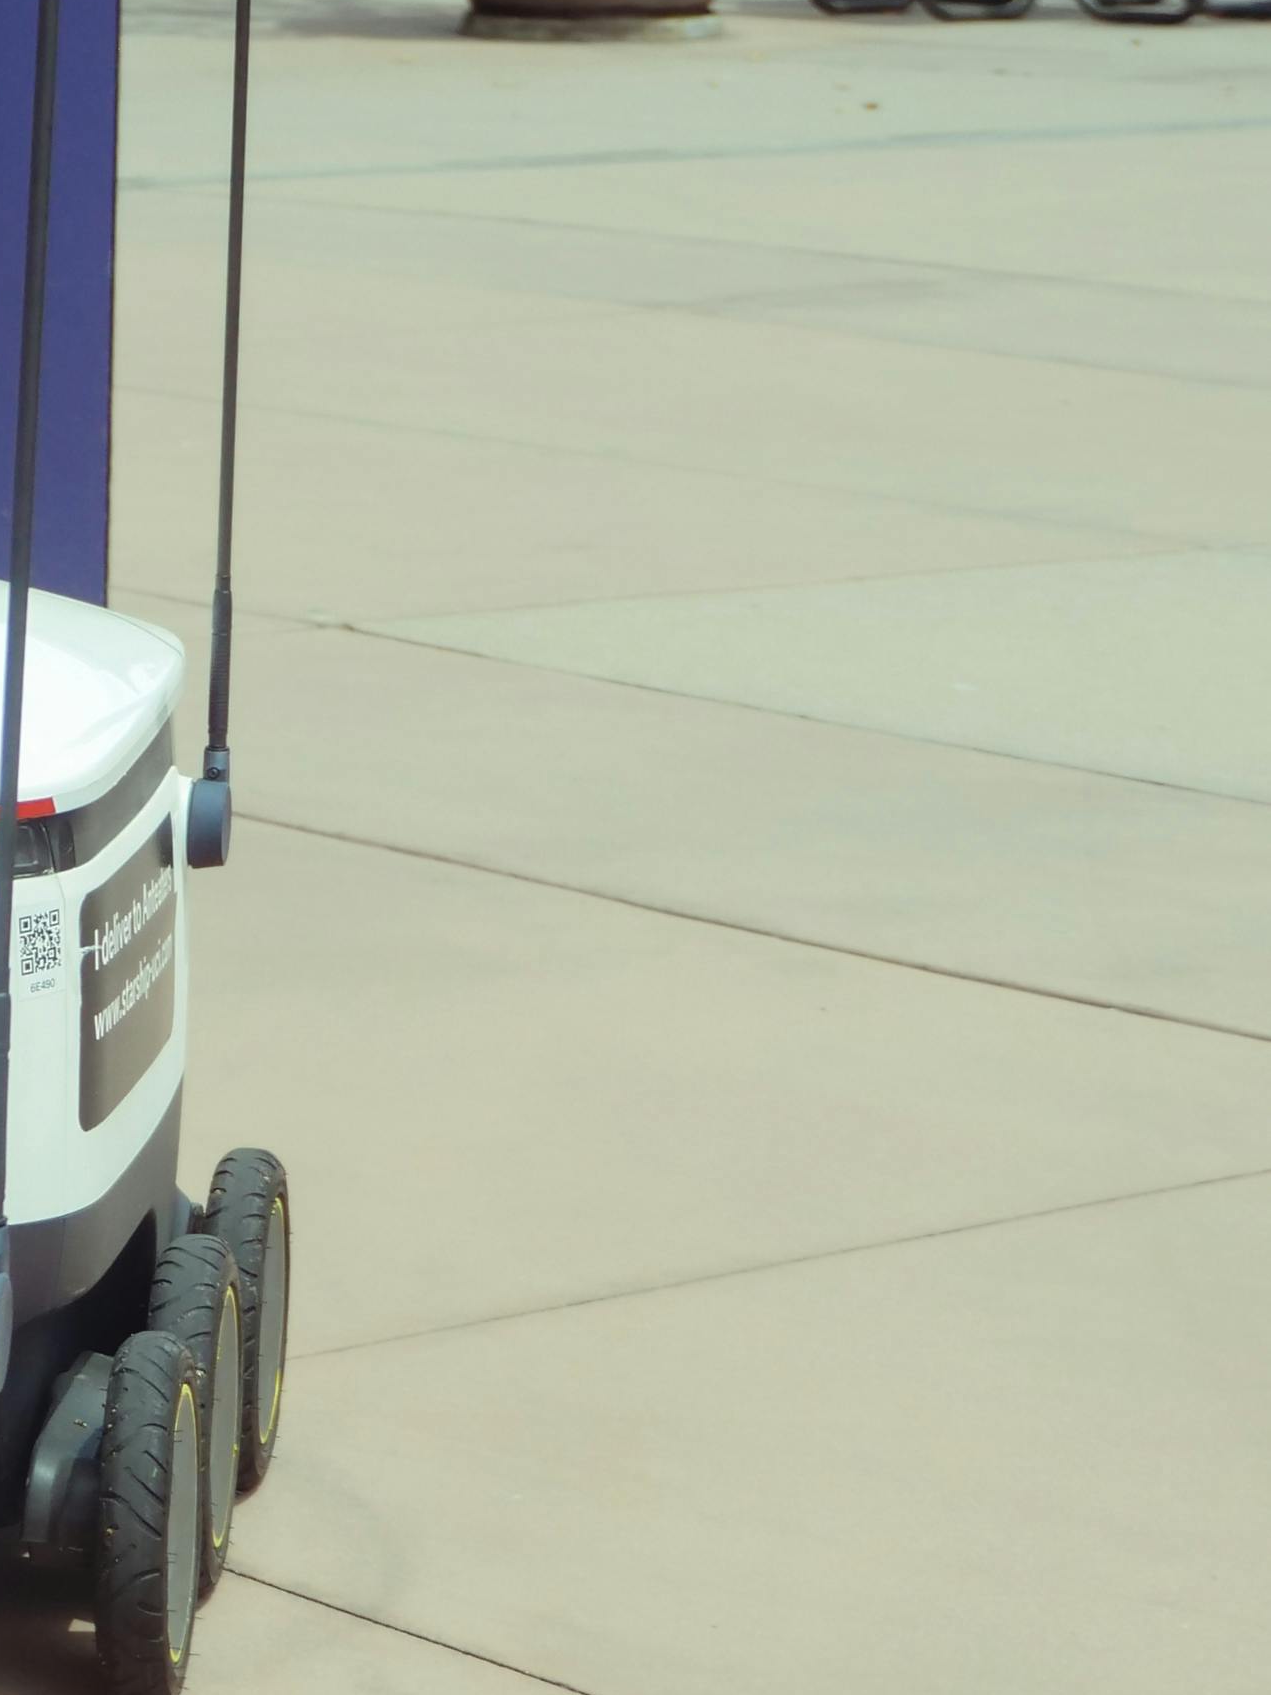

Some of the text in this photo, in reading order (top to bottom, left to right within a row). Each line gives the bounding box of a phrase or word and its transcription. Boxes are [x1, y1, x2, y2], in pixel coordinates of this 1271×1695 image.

[94, 928, 100, 971] I
[102, 911, 132, 966] deliver
[133, 898, 142, 934] to
